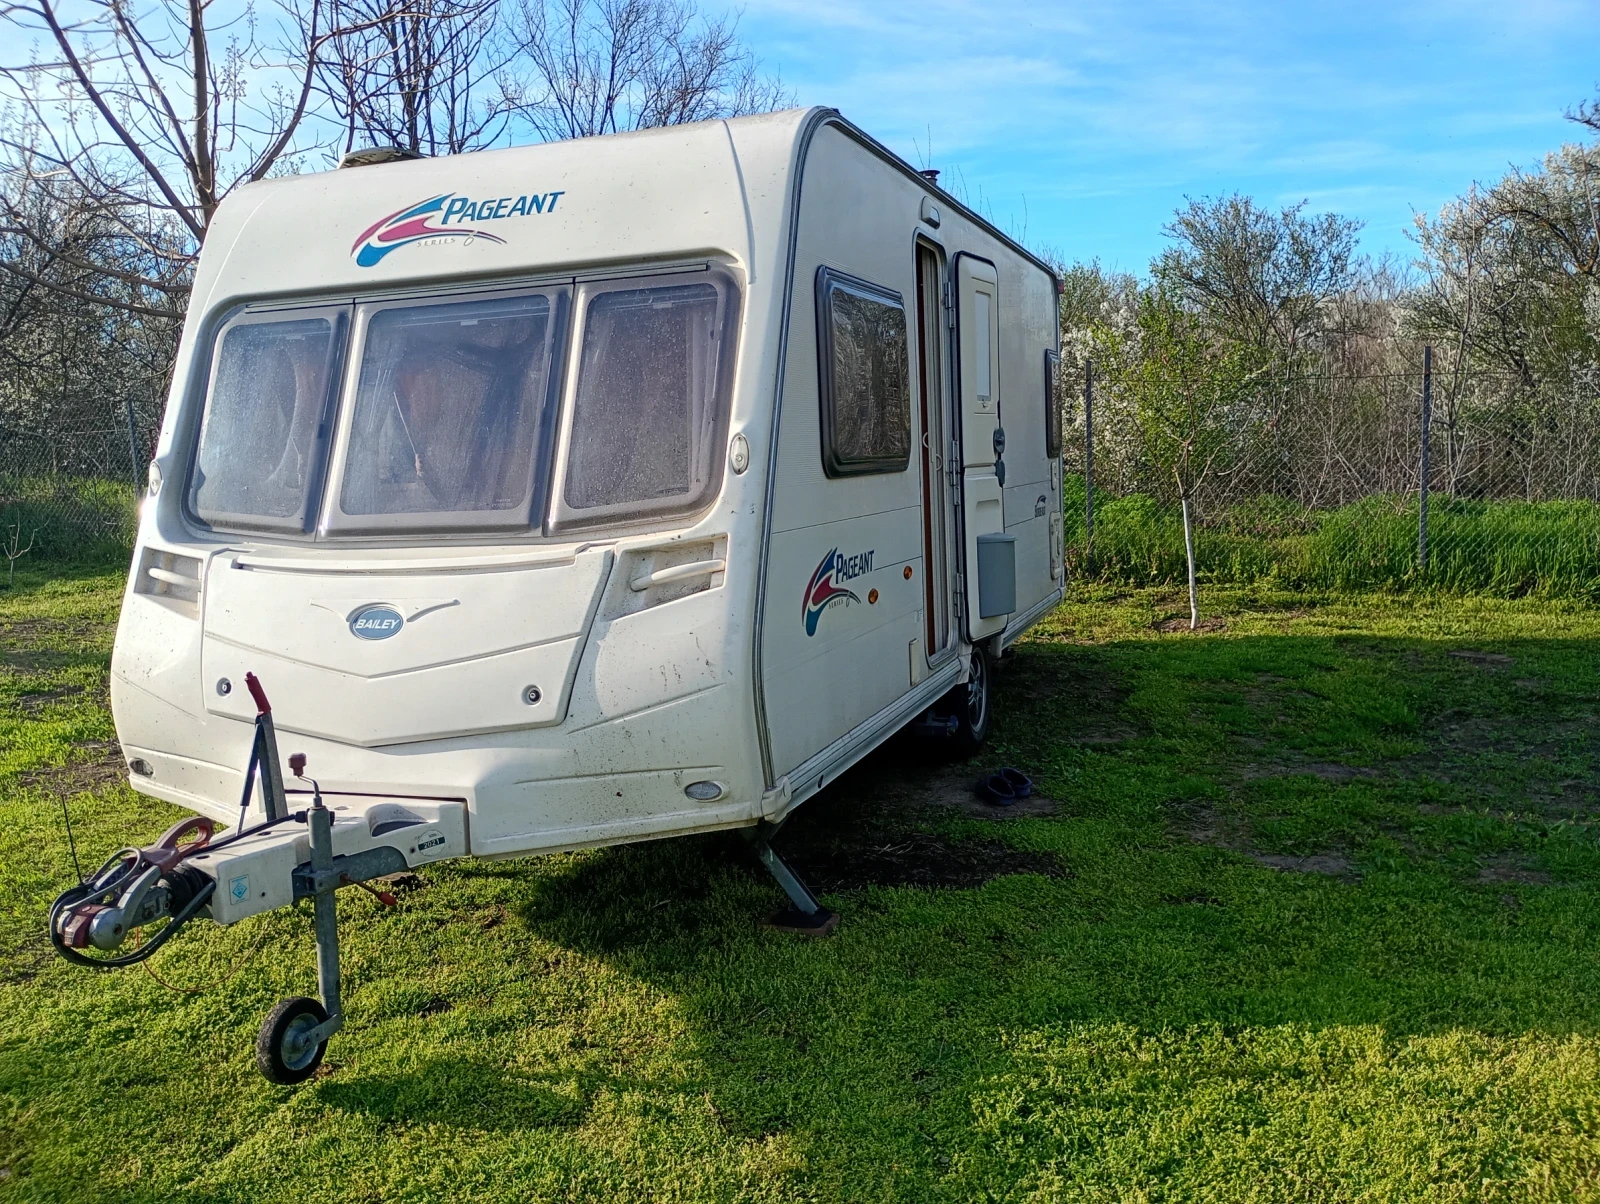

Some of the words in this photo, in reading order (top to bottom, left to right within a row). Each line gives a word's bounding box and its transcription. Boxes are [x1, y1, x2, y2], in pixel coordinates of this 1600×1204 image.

[441, 191, 565, 225] PAGEANT
[416, 237, 456, 248] SERIES
[836, 549, 875, 585] PAGEANT
[828, 598, 844, 610] SERIES
[355, 618, 400, 630] BAILEY
